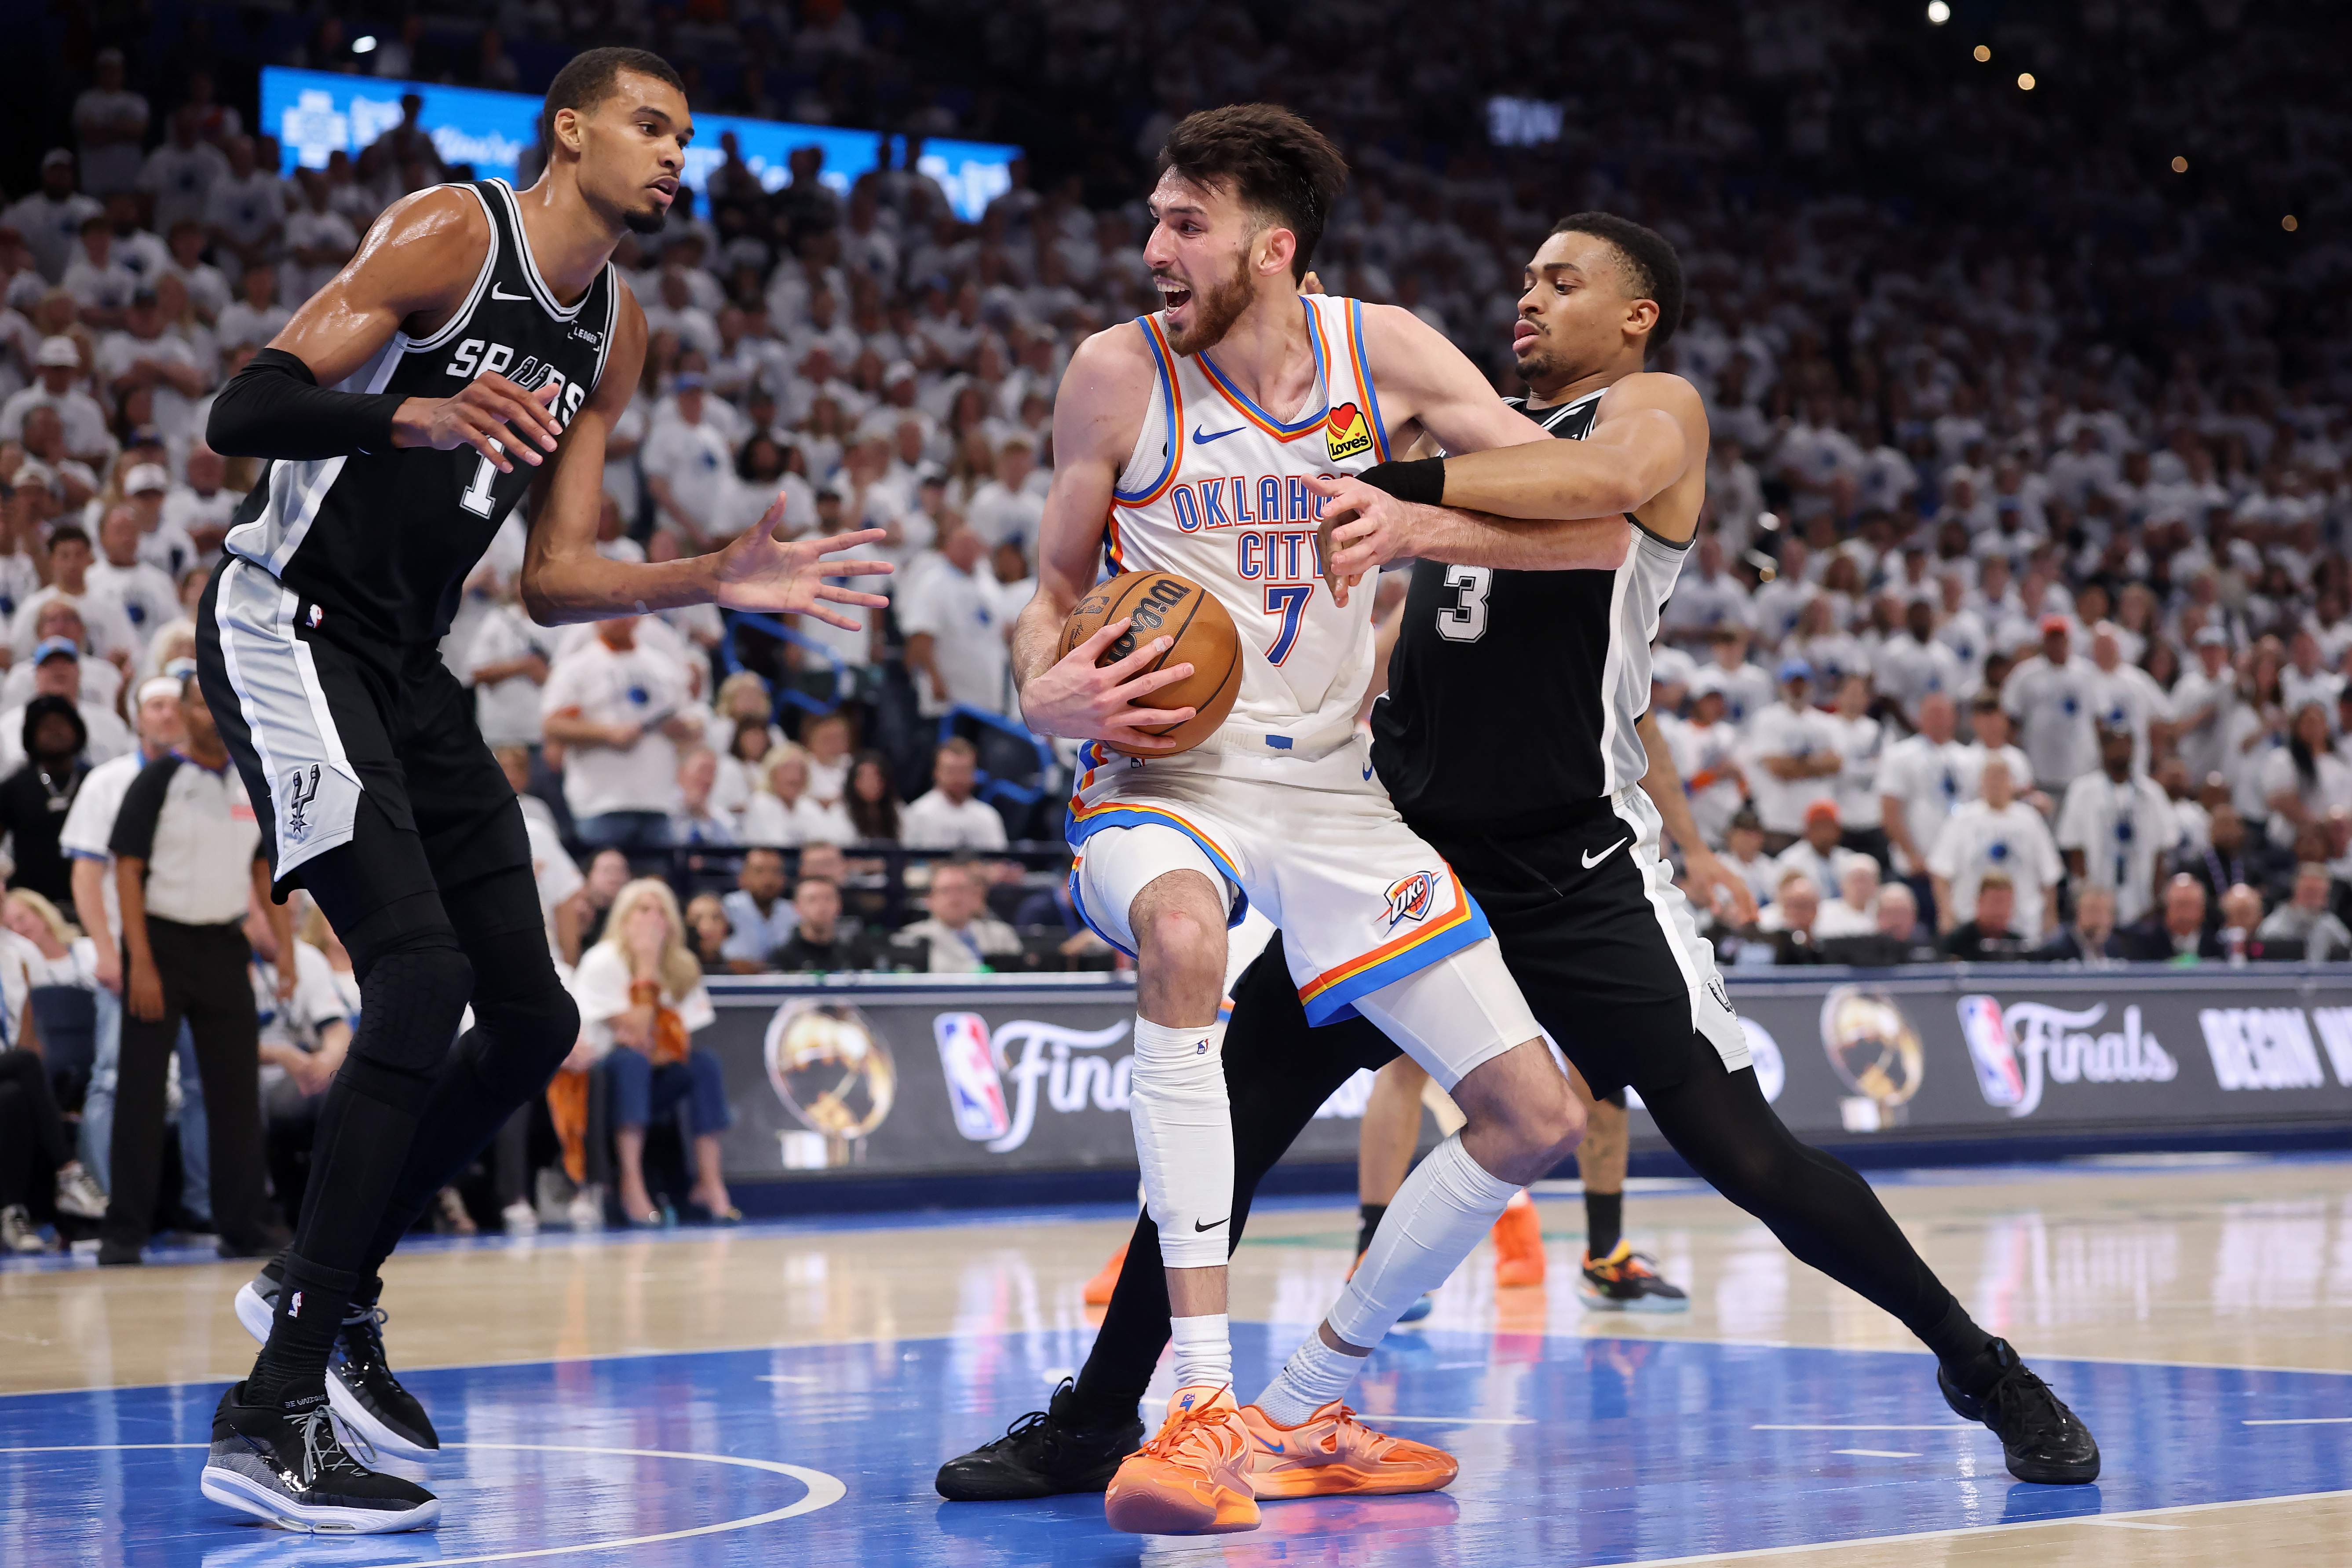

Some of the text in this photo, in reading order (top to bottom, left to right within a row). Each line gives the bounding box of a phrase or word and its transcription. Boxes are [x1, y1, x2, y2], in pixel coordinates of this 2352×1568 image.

[459, 431, 504, 519] 1
[1170, 472, 1354, 534] OKLAH
[1264, 584, 1315, 668] 7
[1435, 563, 1493, 643] 3
[1390, 876, 1425, 925] OKC
[986, 1020, 1134, 1154] Fin
[2004, 1001, 2179, 1118] Finals
